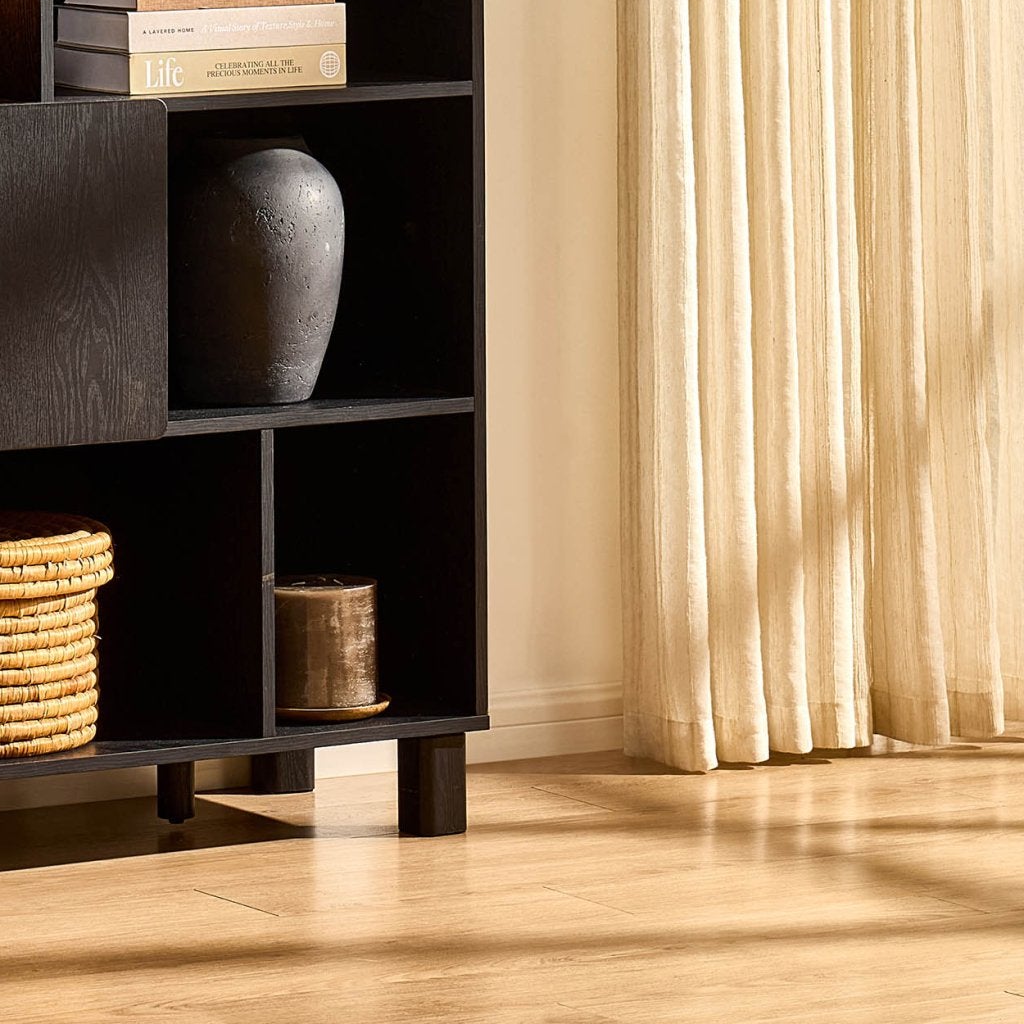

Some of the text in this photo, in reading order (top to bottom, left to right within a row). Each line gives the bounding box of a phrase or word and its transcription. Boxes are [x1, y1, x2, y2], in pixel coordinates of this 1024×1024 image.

[214, 61, 264, 69] CELEBRATING
[144, 57, 184, 89] Life
[206, 69, 241, 77] PRECIOUS
[242, 67, 277, 75] MOMENTS
[287, 66, 303, 74] LIFE
